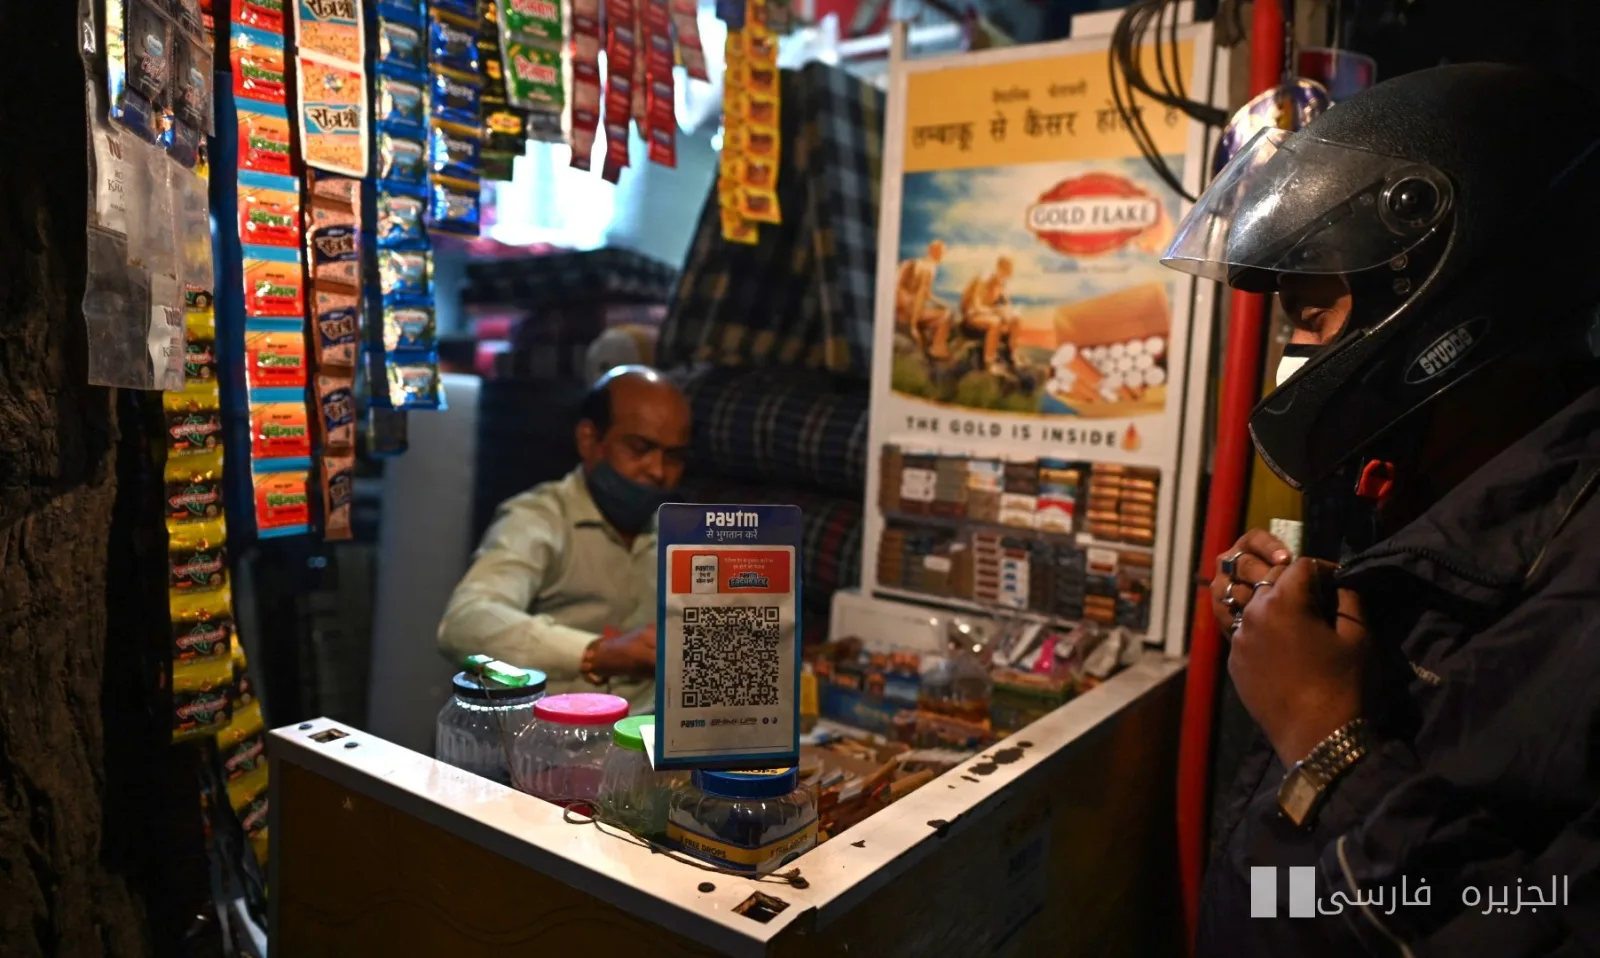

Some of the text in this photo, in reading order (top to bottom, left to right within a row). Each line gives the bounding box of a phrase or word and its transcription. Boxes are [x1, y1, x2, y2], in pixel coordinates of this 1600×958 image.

[989, 112, 1007, 141] से
[1033, 204, 1149, 226] GOLD FLAKE
[1419, 327, 1473, 375] STUDDS
[906, 416, 1117, 447] THE GOLD IS INSIDE
[705, 528, 758, 541] से भुगतान करें
[701, 843, 727, 858] DROPS
